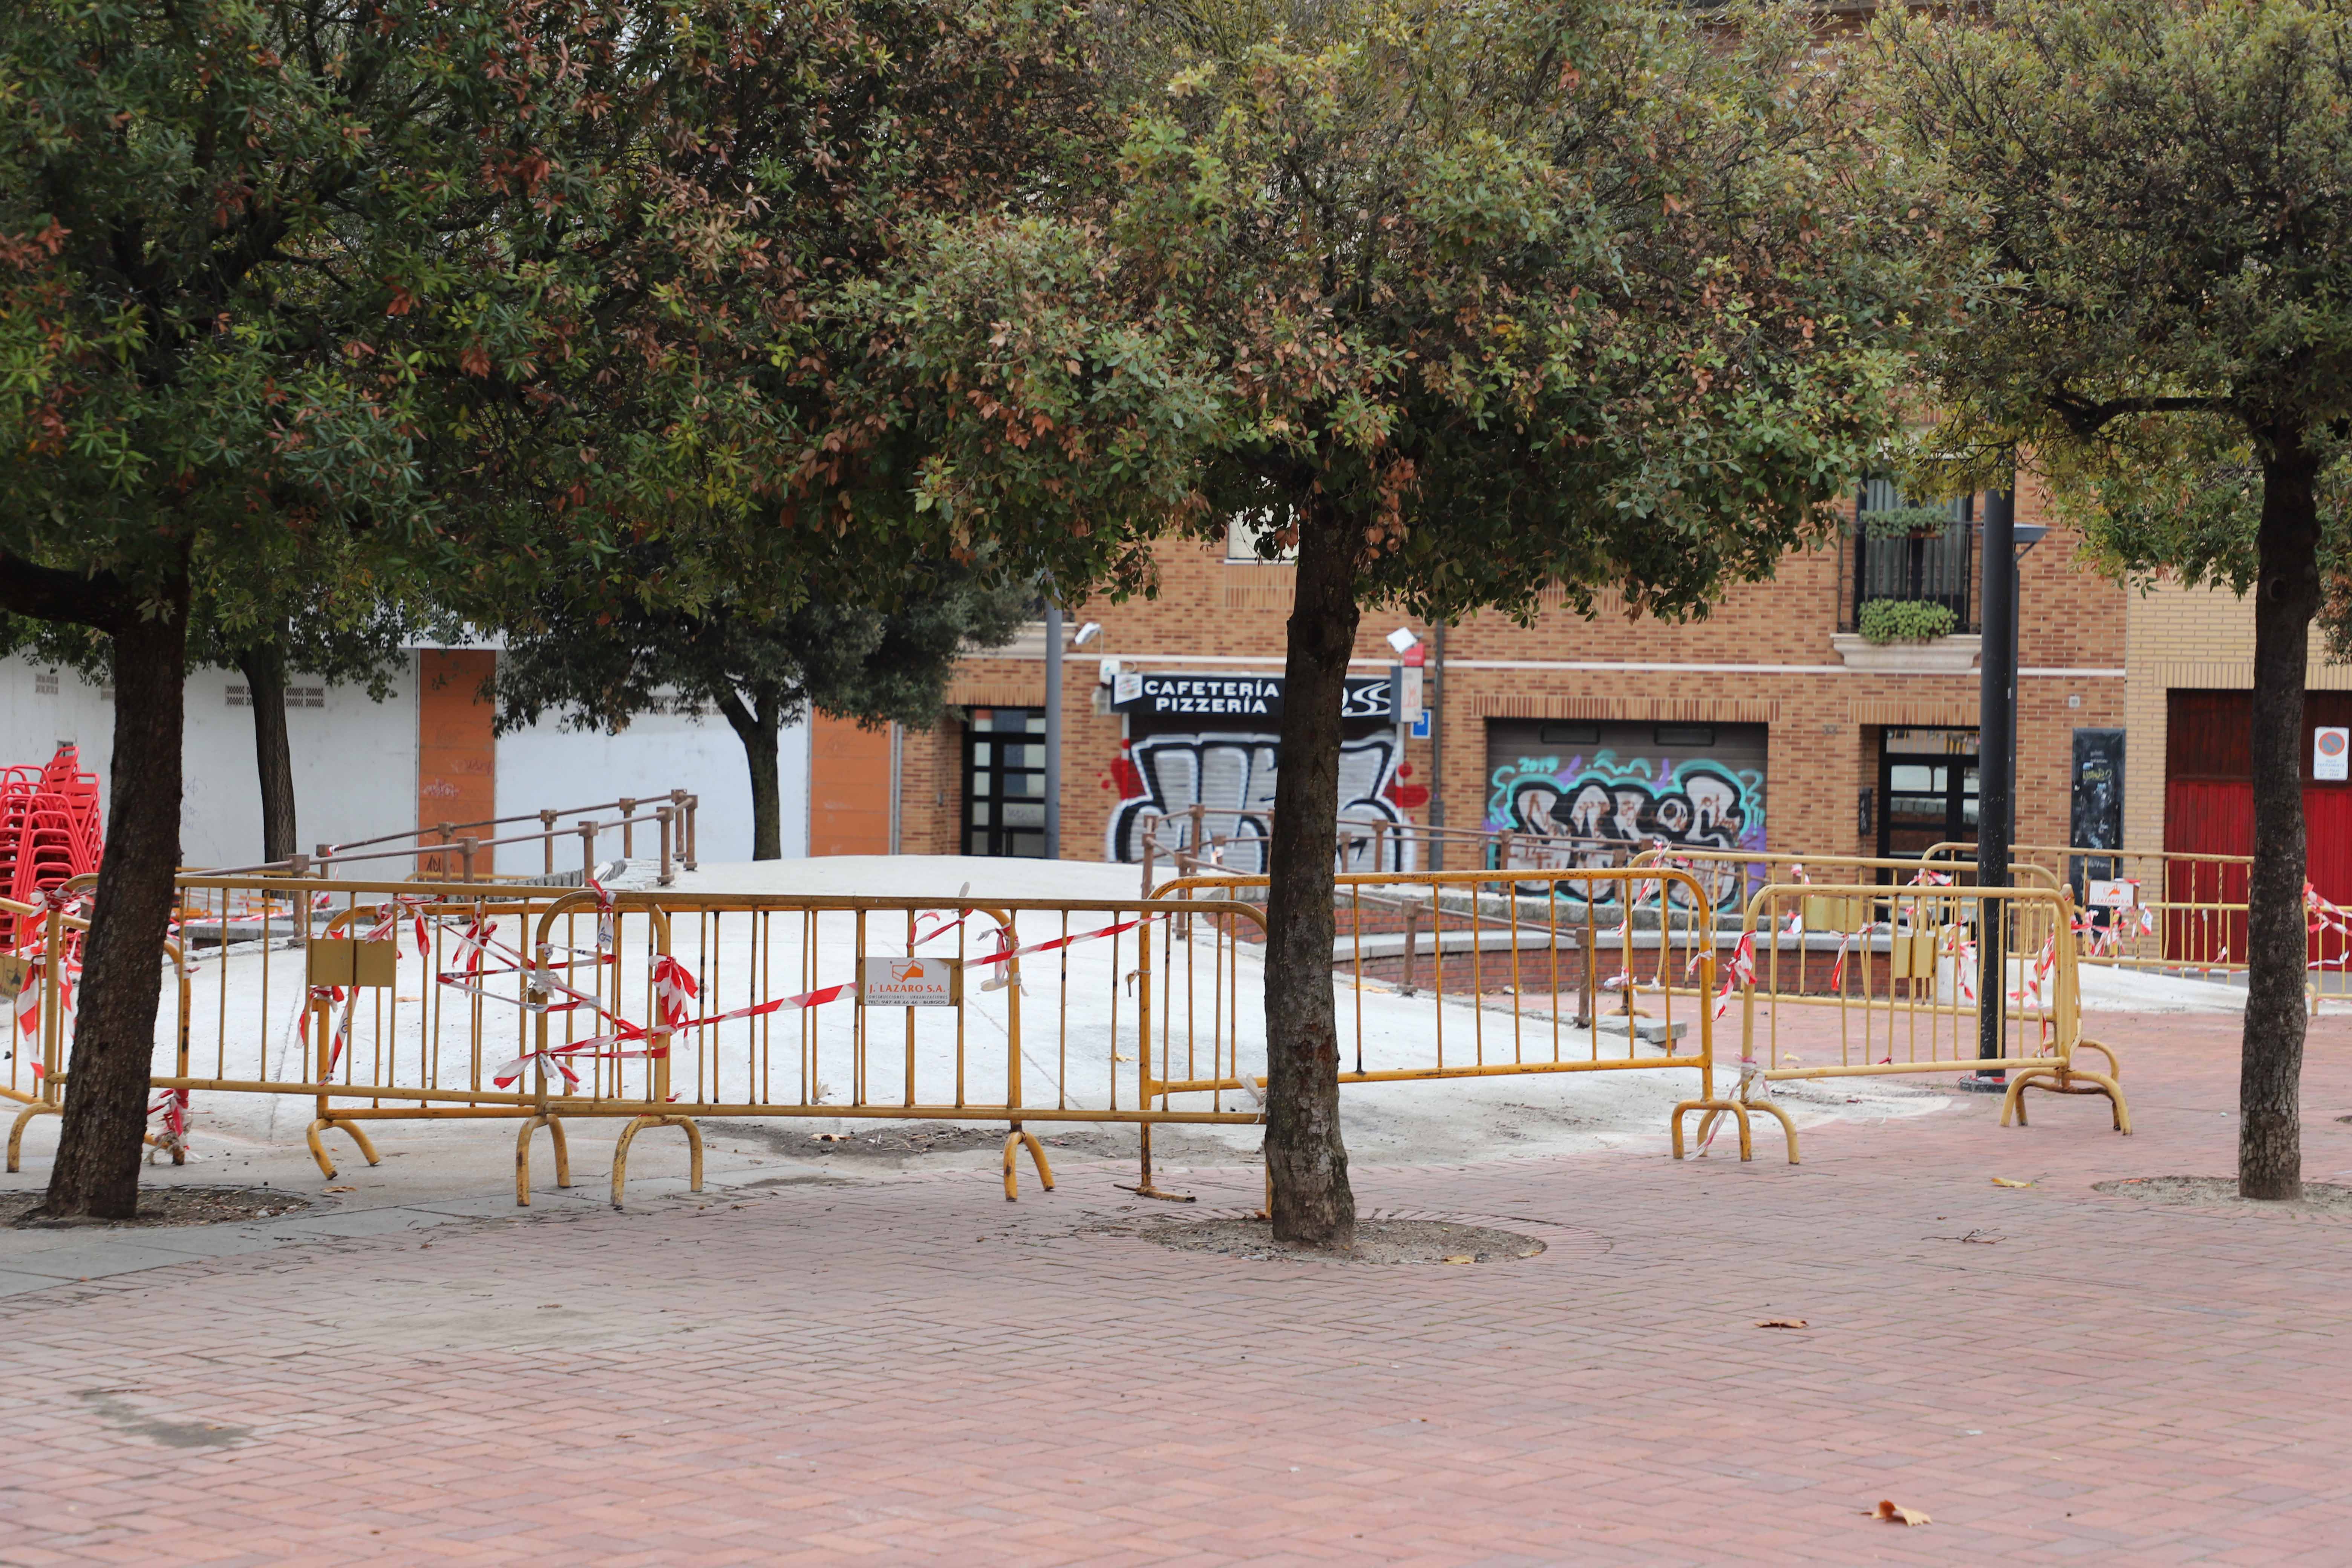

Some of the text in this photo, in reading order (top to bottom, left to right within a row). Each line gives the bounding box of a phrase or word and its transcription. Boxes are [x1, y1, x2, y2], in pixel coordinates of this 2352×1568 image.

[1144, 680, 1279, 697] CAFETERÍA
[1156, 696, 1267, 713] PIZZERÍA
[869, 984, 946, 994] J. LAZARO S.A.
